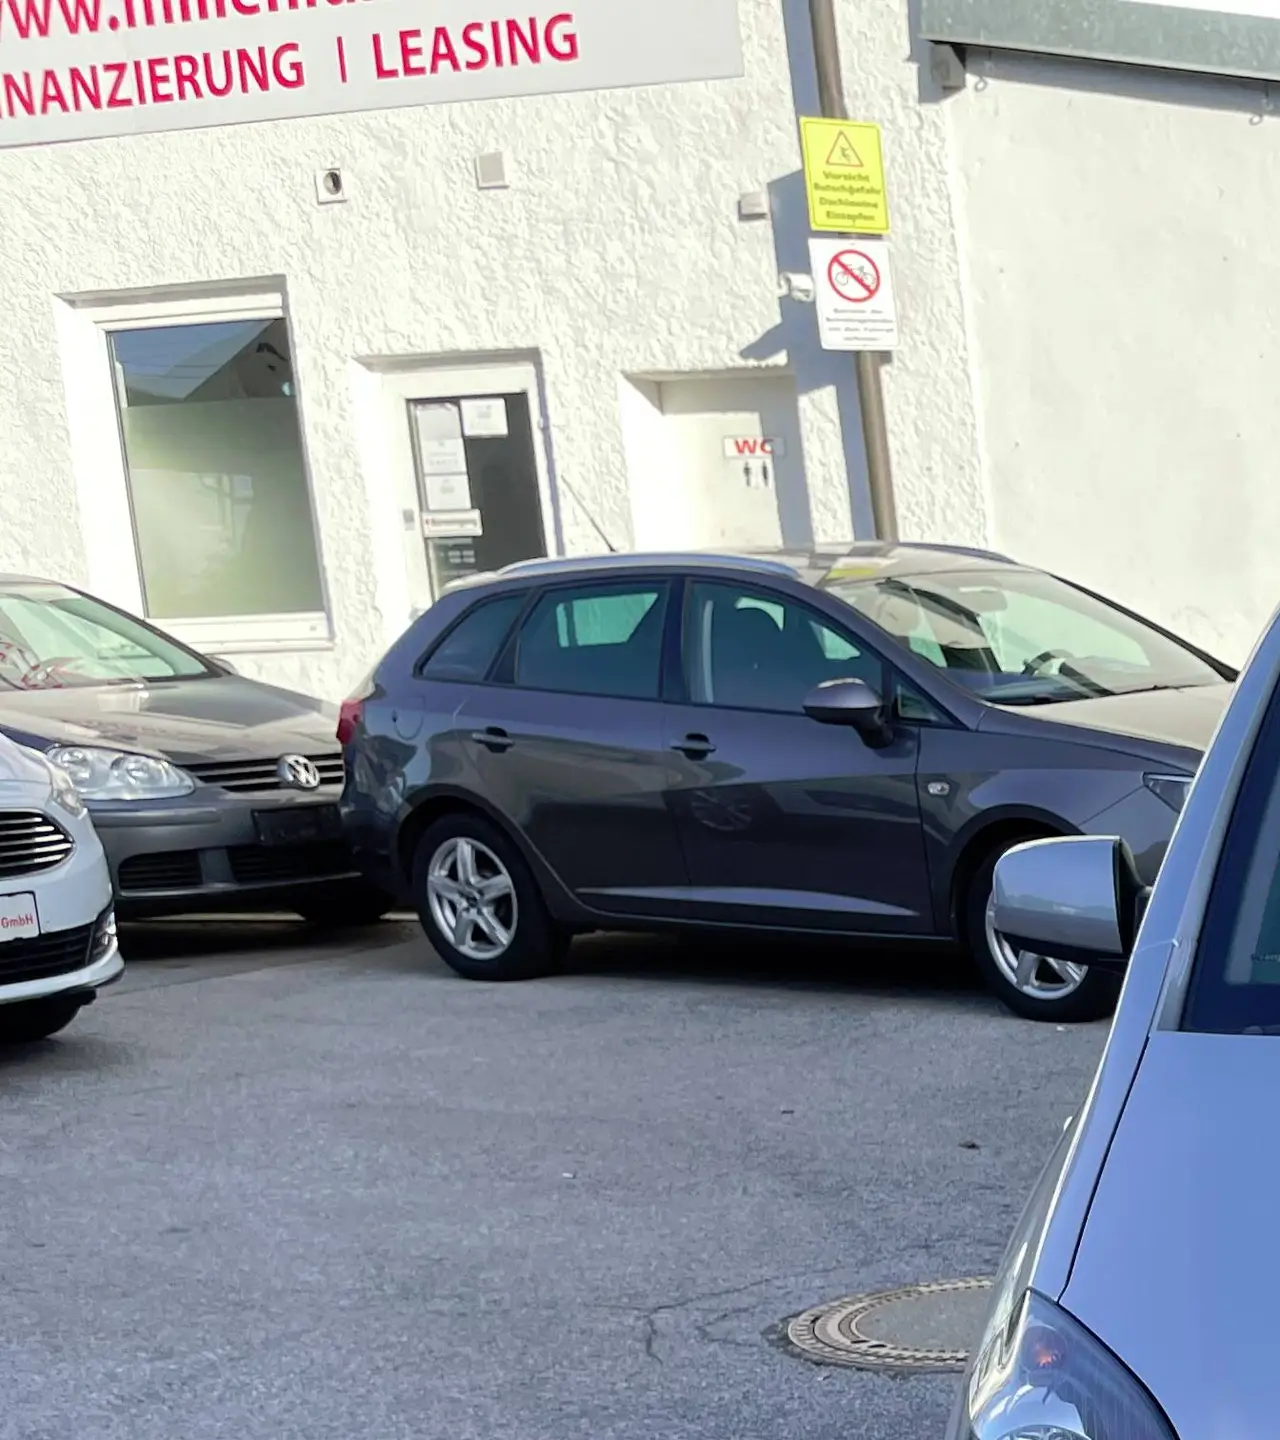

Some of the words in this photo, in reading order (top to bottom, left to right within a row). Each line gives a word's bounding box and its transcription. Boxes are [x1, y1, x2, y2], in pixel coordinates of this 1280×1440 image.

[0, 42, 305, 119] NANZIERUNG
[372, 13, 579, 80] LEASING
[734, 438, 776, 454] WC
[0, 913, 34, 928] GmbH
